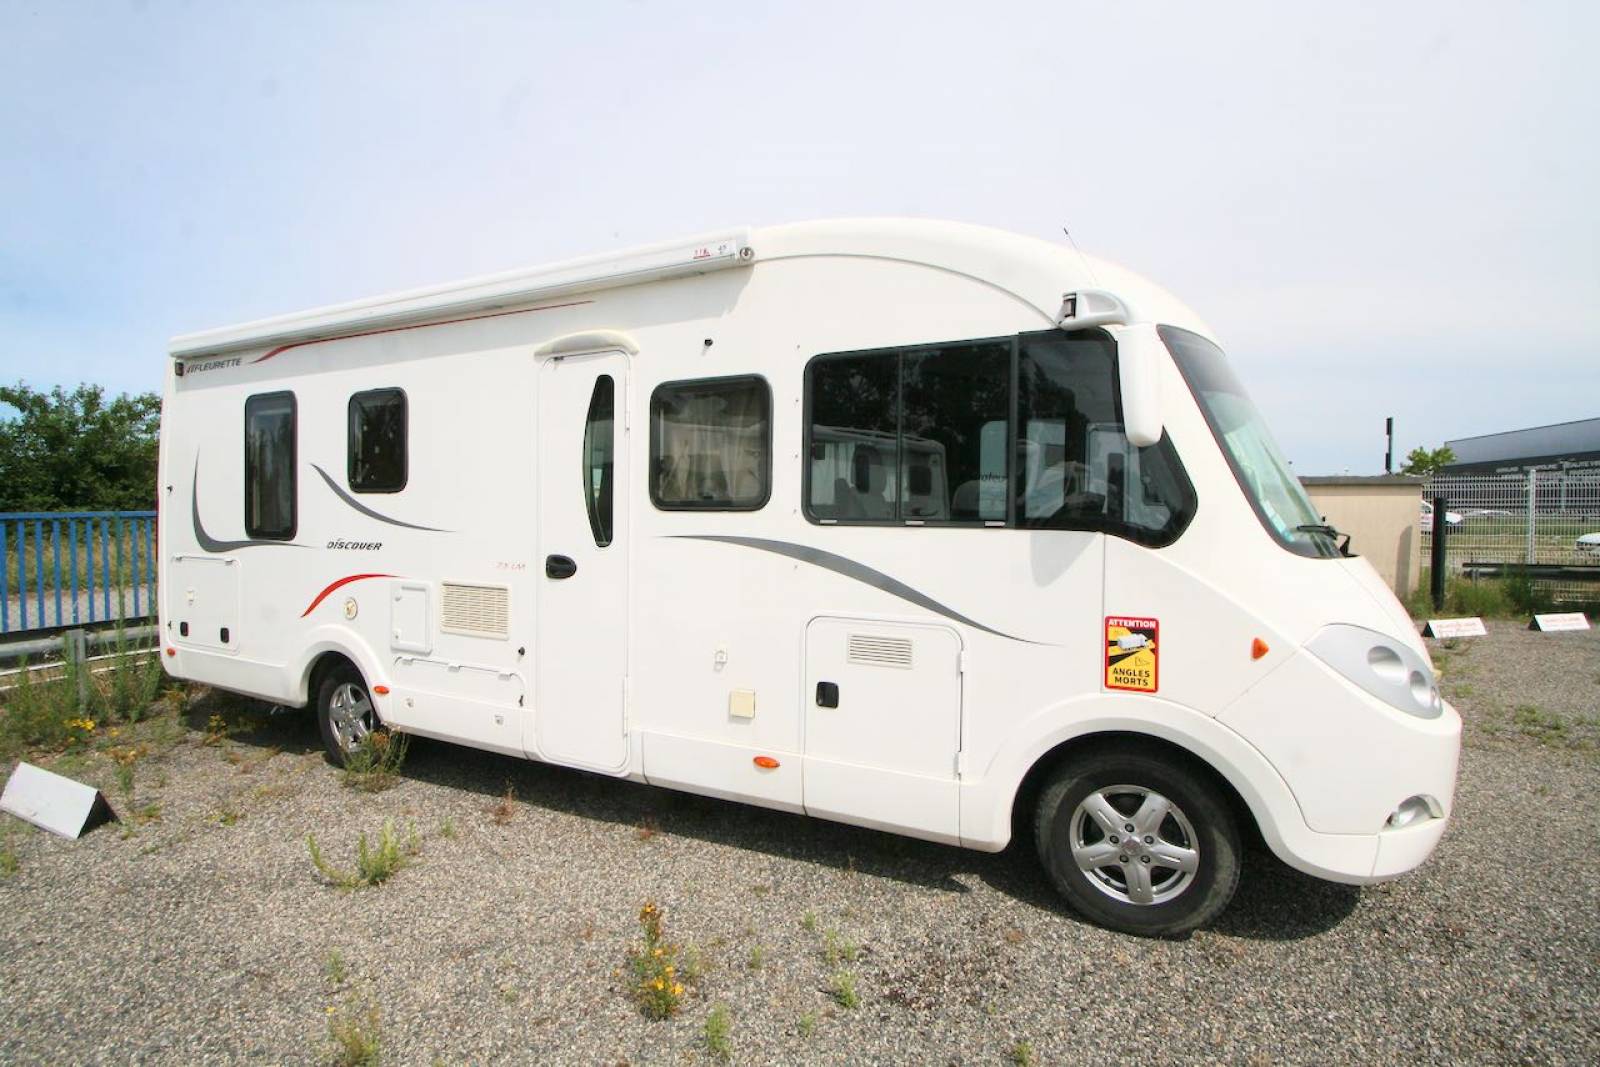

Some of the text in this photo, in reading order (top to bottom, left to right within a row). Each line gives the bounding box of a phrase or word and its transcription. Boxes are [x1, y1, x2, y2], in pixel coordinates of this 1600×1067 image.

[194, 357, 242, 372] FLEURETTE
[326, 538, 382, 551] DISCOVER
[1108, 619, 1156, 629] ATTENTION
[1113, 667, 1150, 678] ANGLES
[1115, 676, 1149, 687] MORTS
